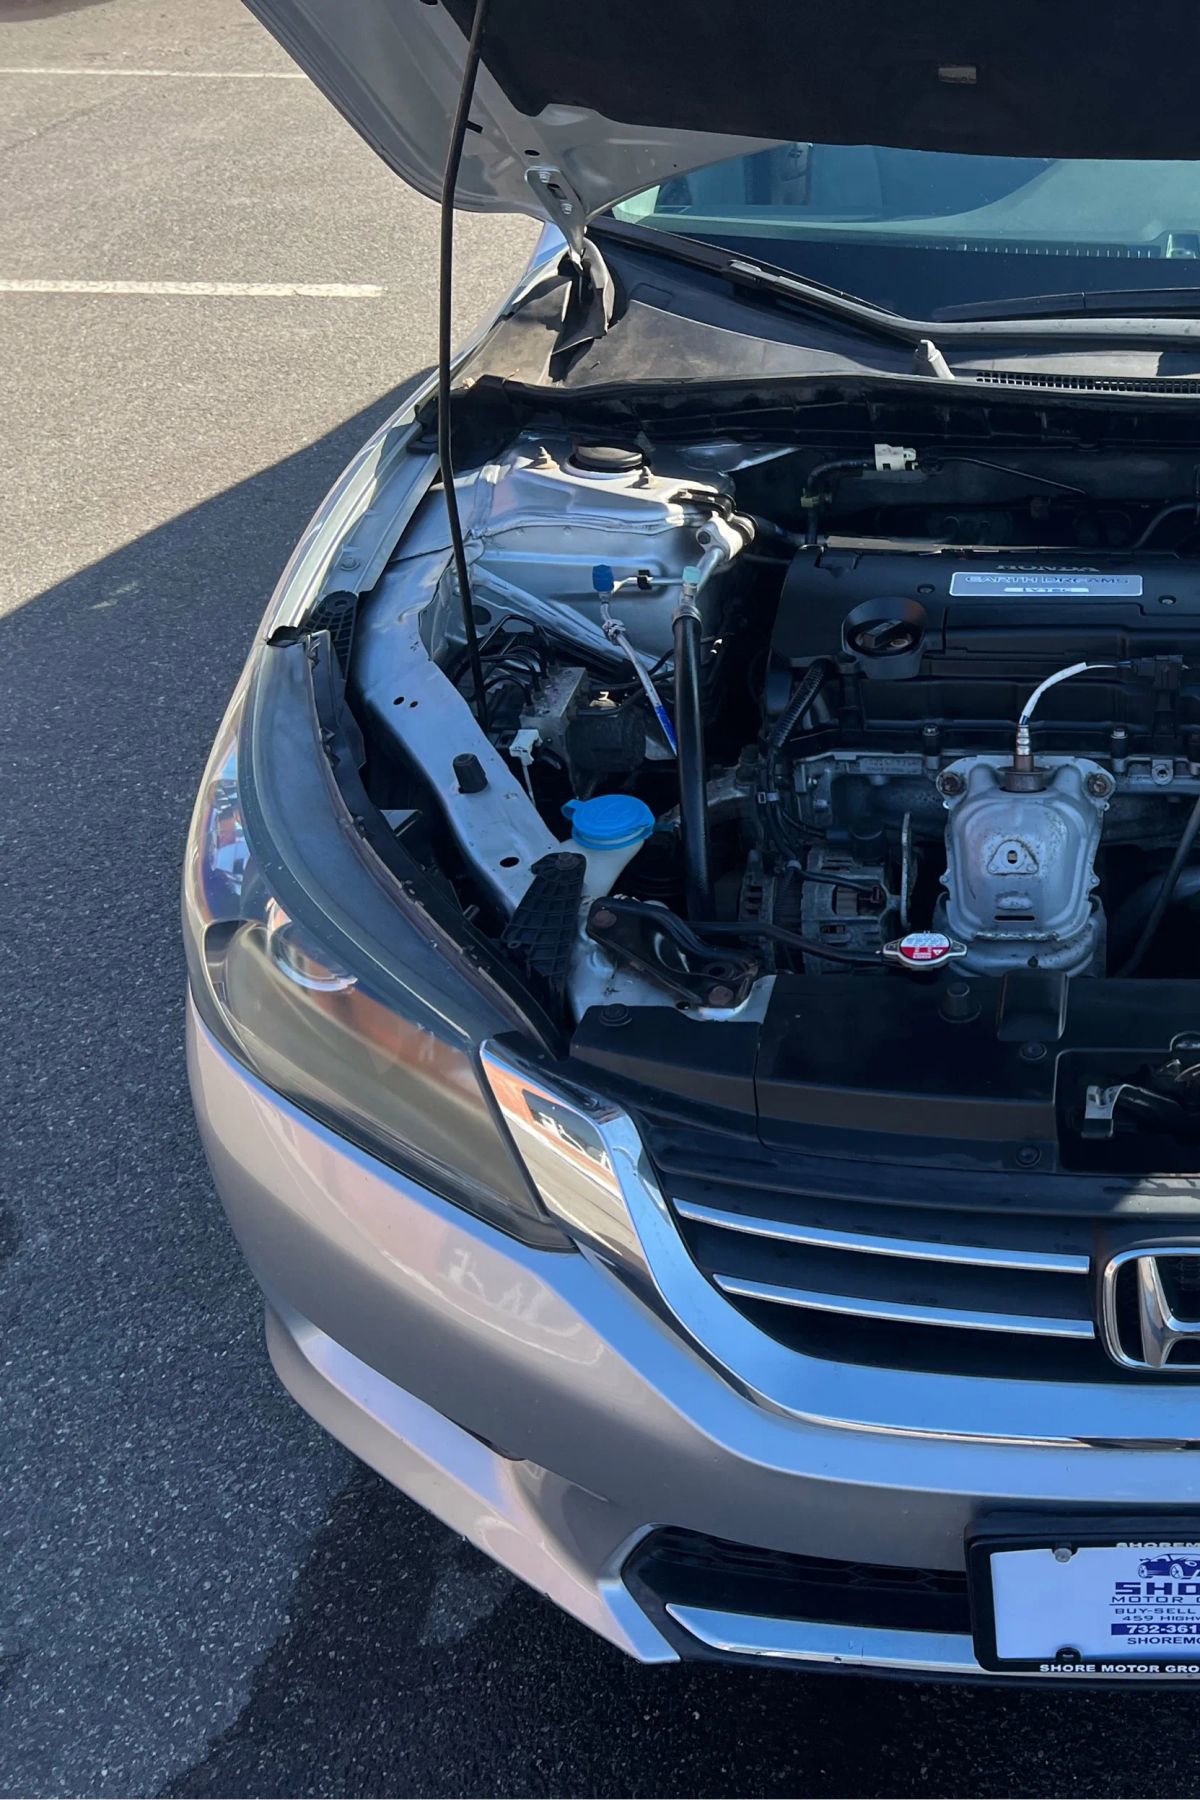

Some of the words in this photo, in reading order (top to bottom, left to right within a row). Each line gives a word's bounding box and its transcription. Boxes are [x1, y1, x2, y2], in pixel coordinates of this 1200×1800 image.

[995, 564, 1101, 572] HONDA
[965, 575, 1039, 584] EARTH
[1041, 576, 1129, 585] DREAMS
[1111, 1596, 1184, 1604] MOTOR
[1039, 1664, 1096, 1673] SHORE
[1101, 1664, 1160, 1673] MOTOR
